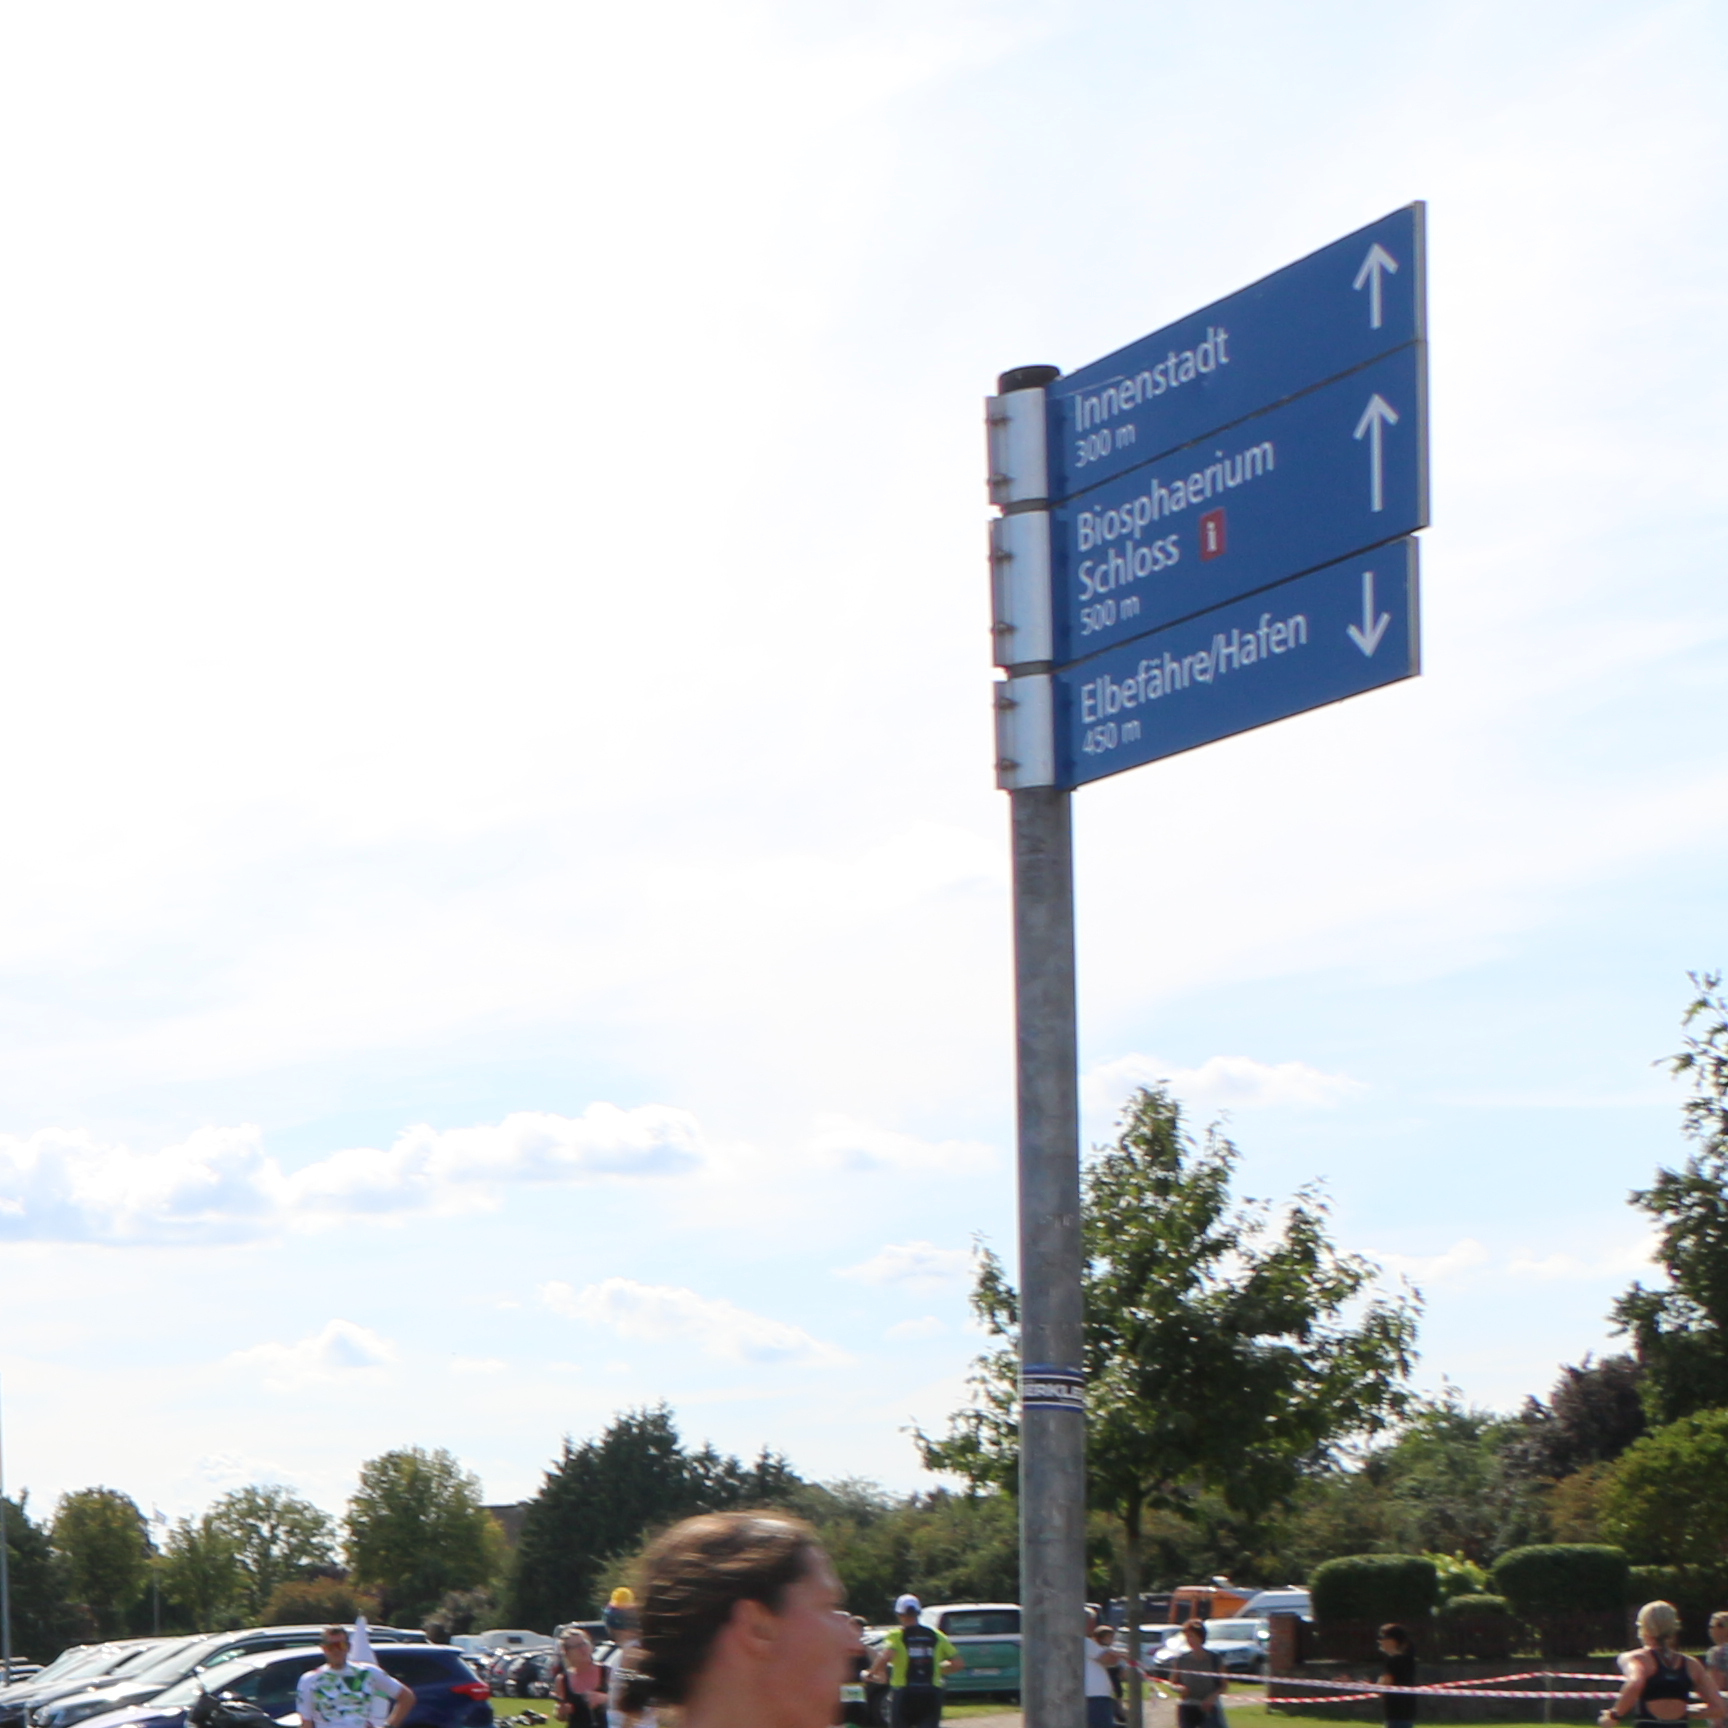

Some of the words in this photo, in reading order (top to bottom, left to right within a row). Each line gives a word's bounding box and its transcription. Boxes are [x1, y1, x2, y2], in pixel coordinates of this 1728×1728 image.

[1074, 325, 1230, 433] Innenstadt
[1074, 428, 1112, 468] 300
[1115, 423, 1136, 449] m
[1076, 441, 1275, 552] Biosphaerium
[1077, 533, 1180, 601] Schloss
[1079, 598, 1117, 636] 500
[1119, 595, 1141, 621] m
[1080, 612, 1308, 724] Elbefähre/Hafen
[1081, 721, 1118, 756] 450
[1121, 719, 1142, 744] m
